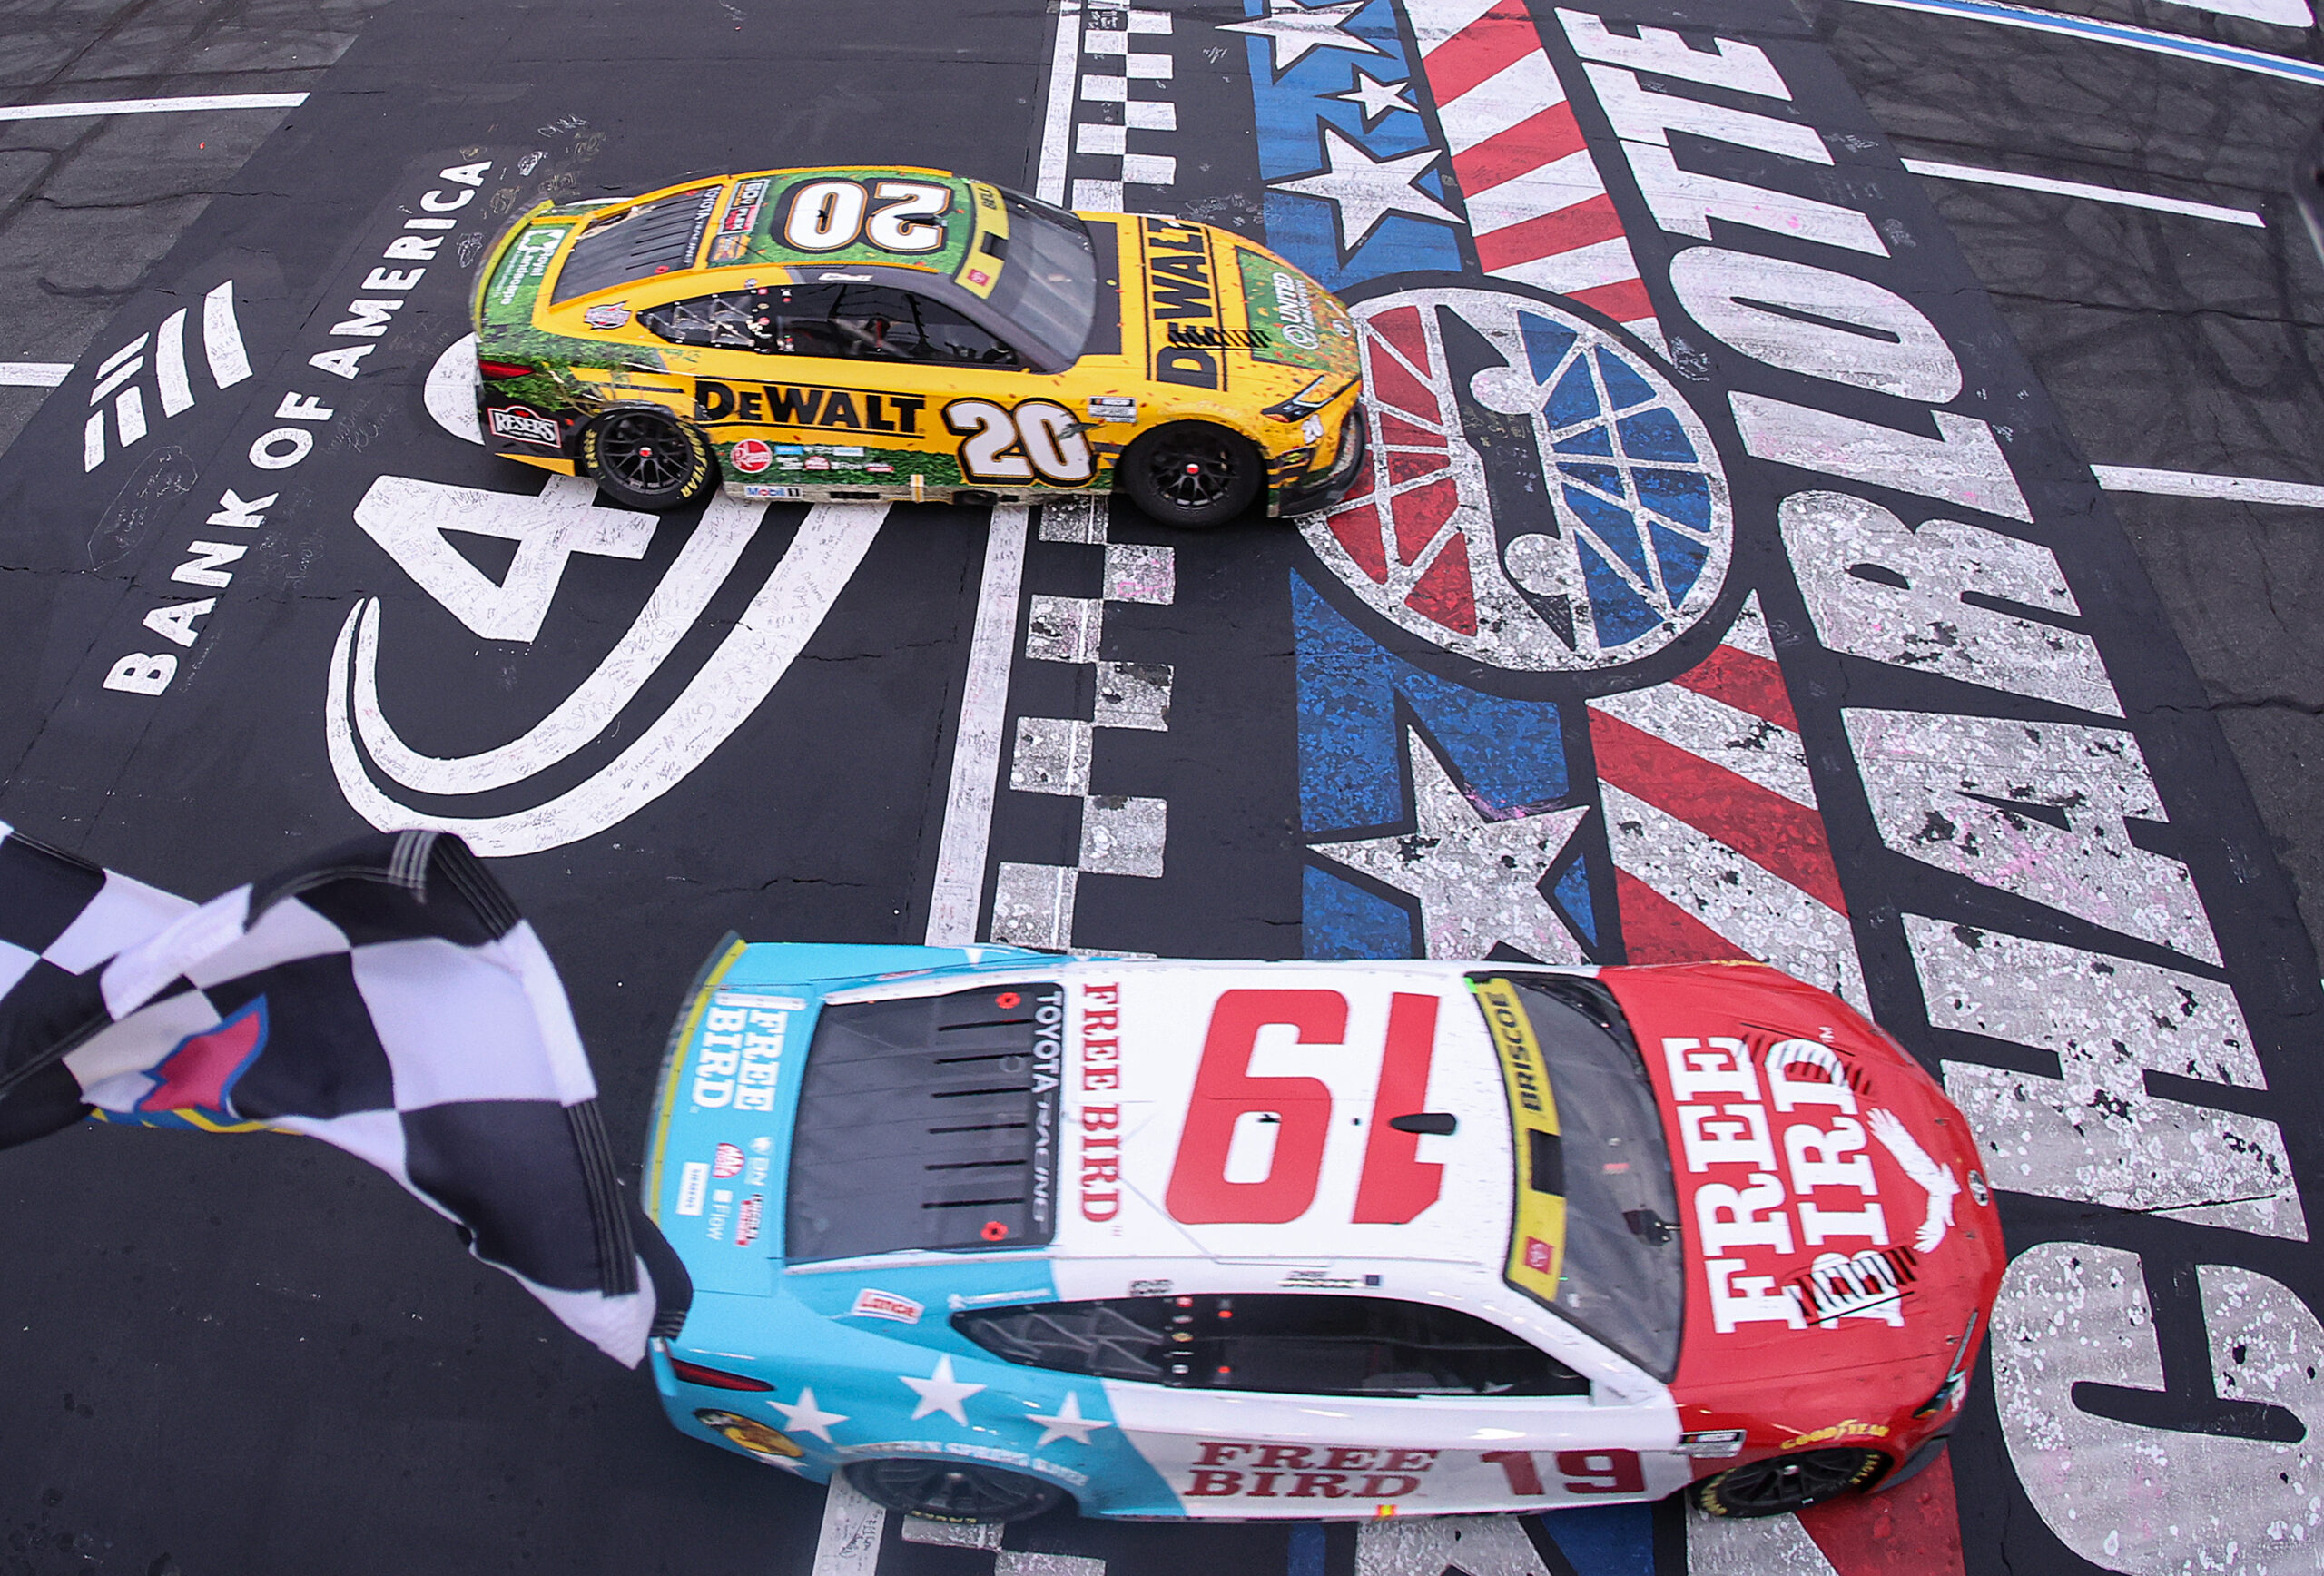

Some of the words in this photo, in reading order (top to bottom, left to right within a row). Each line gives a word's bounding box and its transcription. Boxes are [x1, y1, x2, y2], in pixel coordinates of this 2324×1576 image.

[694, 185, 723, 221] TOYOTA
[784, 182, 951, 251] 20
[530, 248, 556, 276] Royal
[1273, 271, 1303, 323] UNITED
[103, 488, 279, 696] BANK
[248, 391, 334, 469] OF
[309, 161, 493, 379] AMERICA
[694, 380, 925, 434] DEWALT
[945, 399, 1093, 482] 20
[745, 487, 785, 497] Mobil
[1554, 7, 2324, 1576] CHARLOTTE
[693, 1007, 744, 1108] BIRD
[734, 1010, 787, 1111] FREE
[1030, 990, 1064, 1094] TOYOTA
[1083, 982, 1122, 1092] FREE
[1484, 990, 1541, 1113] BRISCOE
[1166, 989, 1446, 1225] 19
[1030, 1098, 1053, 1223] RACING
[1080, 1103, 1122, 1224] BIRD
[1661, 1036, 1809, 1333] FREE
[1765, 1038, 1905, 1329] BIRD
[706, 1204, 732, 1241] Flow
[862, 1290, 917, 1317] Lance
[1192, 1442, 1440, 1473] FREE
[1482, 1448, 1648, 1496] 19
[1781, 1418, 1889, 1450] GOODYEAR
[1184, 1469, 1423, 1498] BIRD
